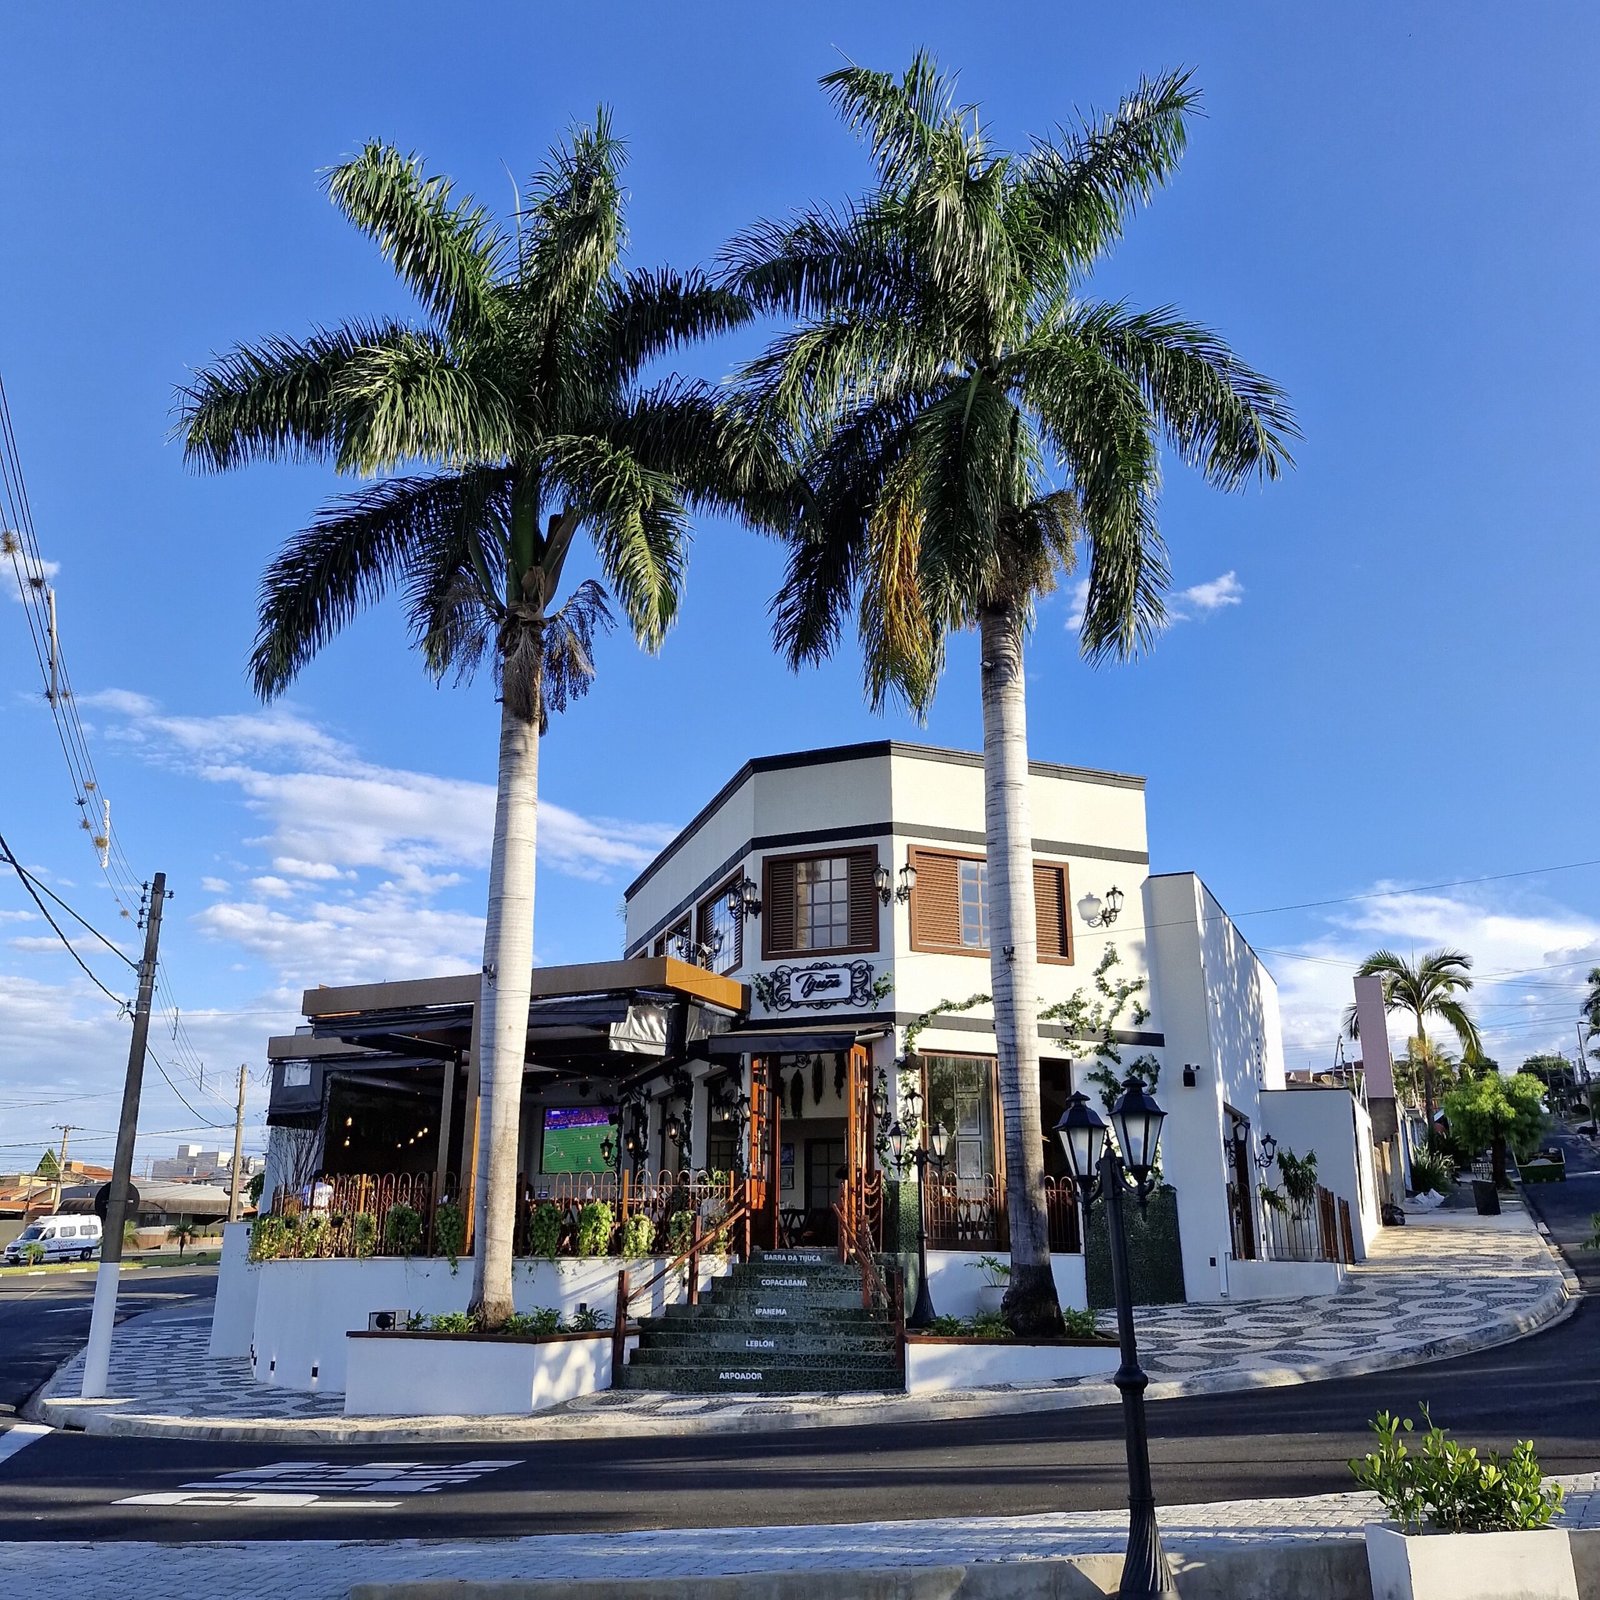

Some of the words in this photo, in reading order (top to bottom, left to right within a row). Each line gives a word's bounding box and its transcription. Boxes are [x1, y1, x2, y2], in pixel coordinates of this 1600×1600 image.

[795, 972, 842, 998] Tijuca
[798, 1254, 821, 1262] TIJUCA
[761, 1279, 808, 1287] COPACABANA
[719, 1372, 763, 1380] ARPOADOR
[110, 1460, 527, 1508] PARE
